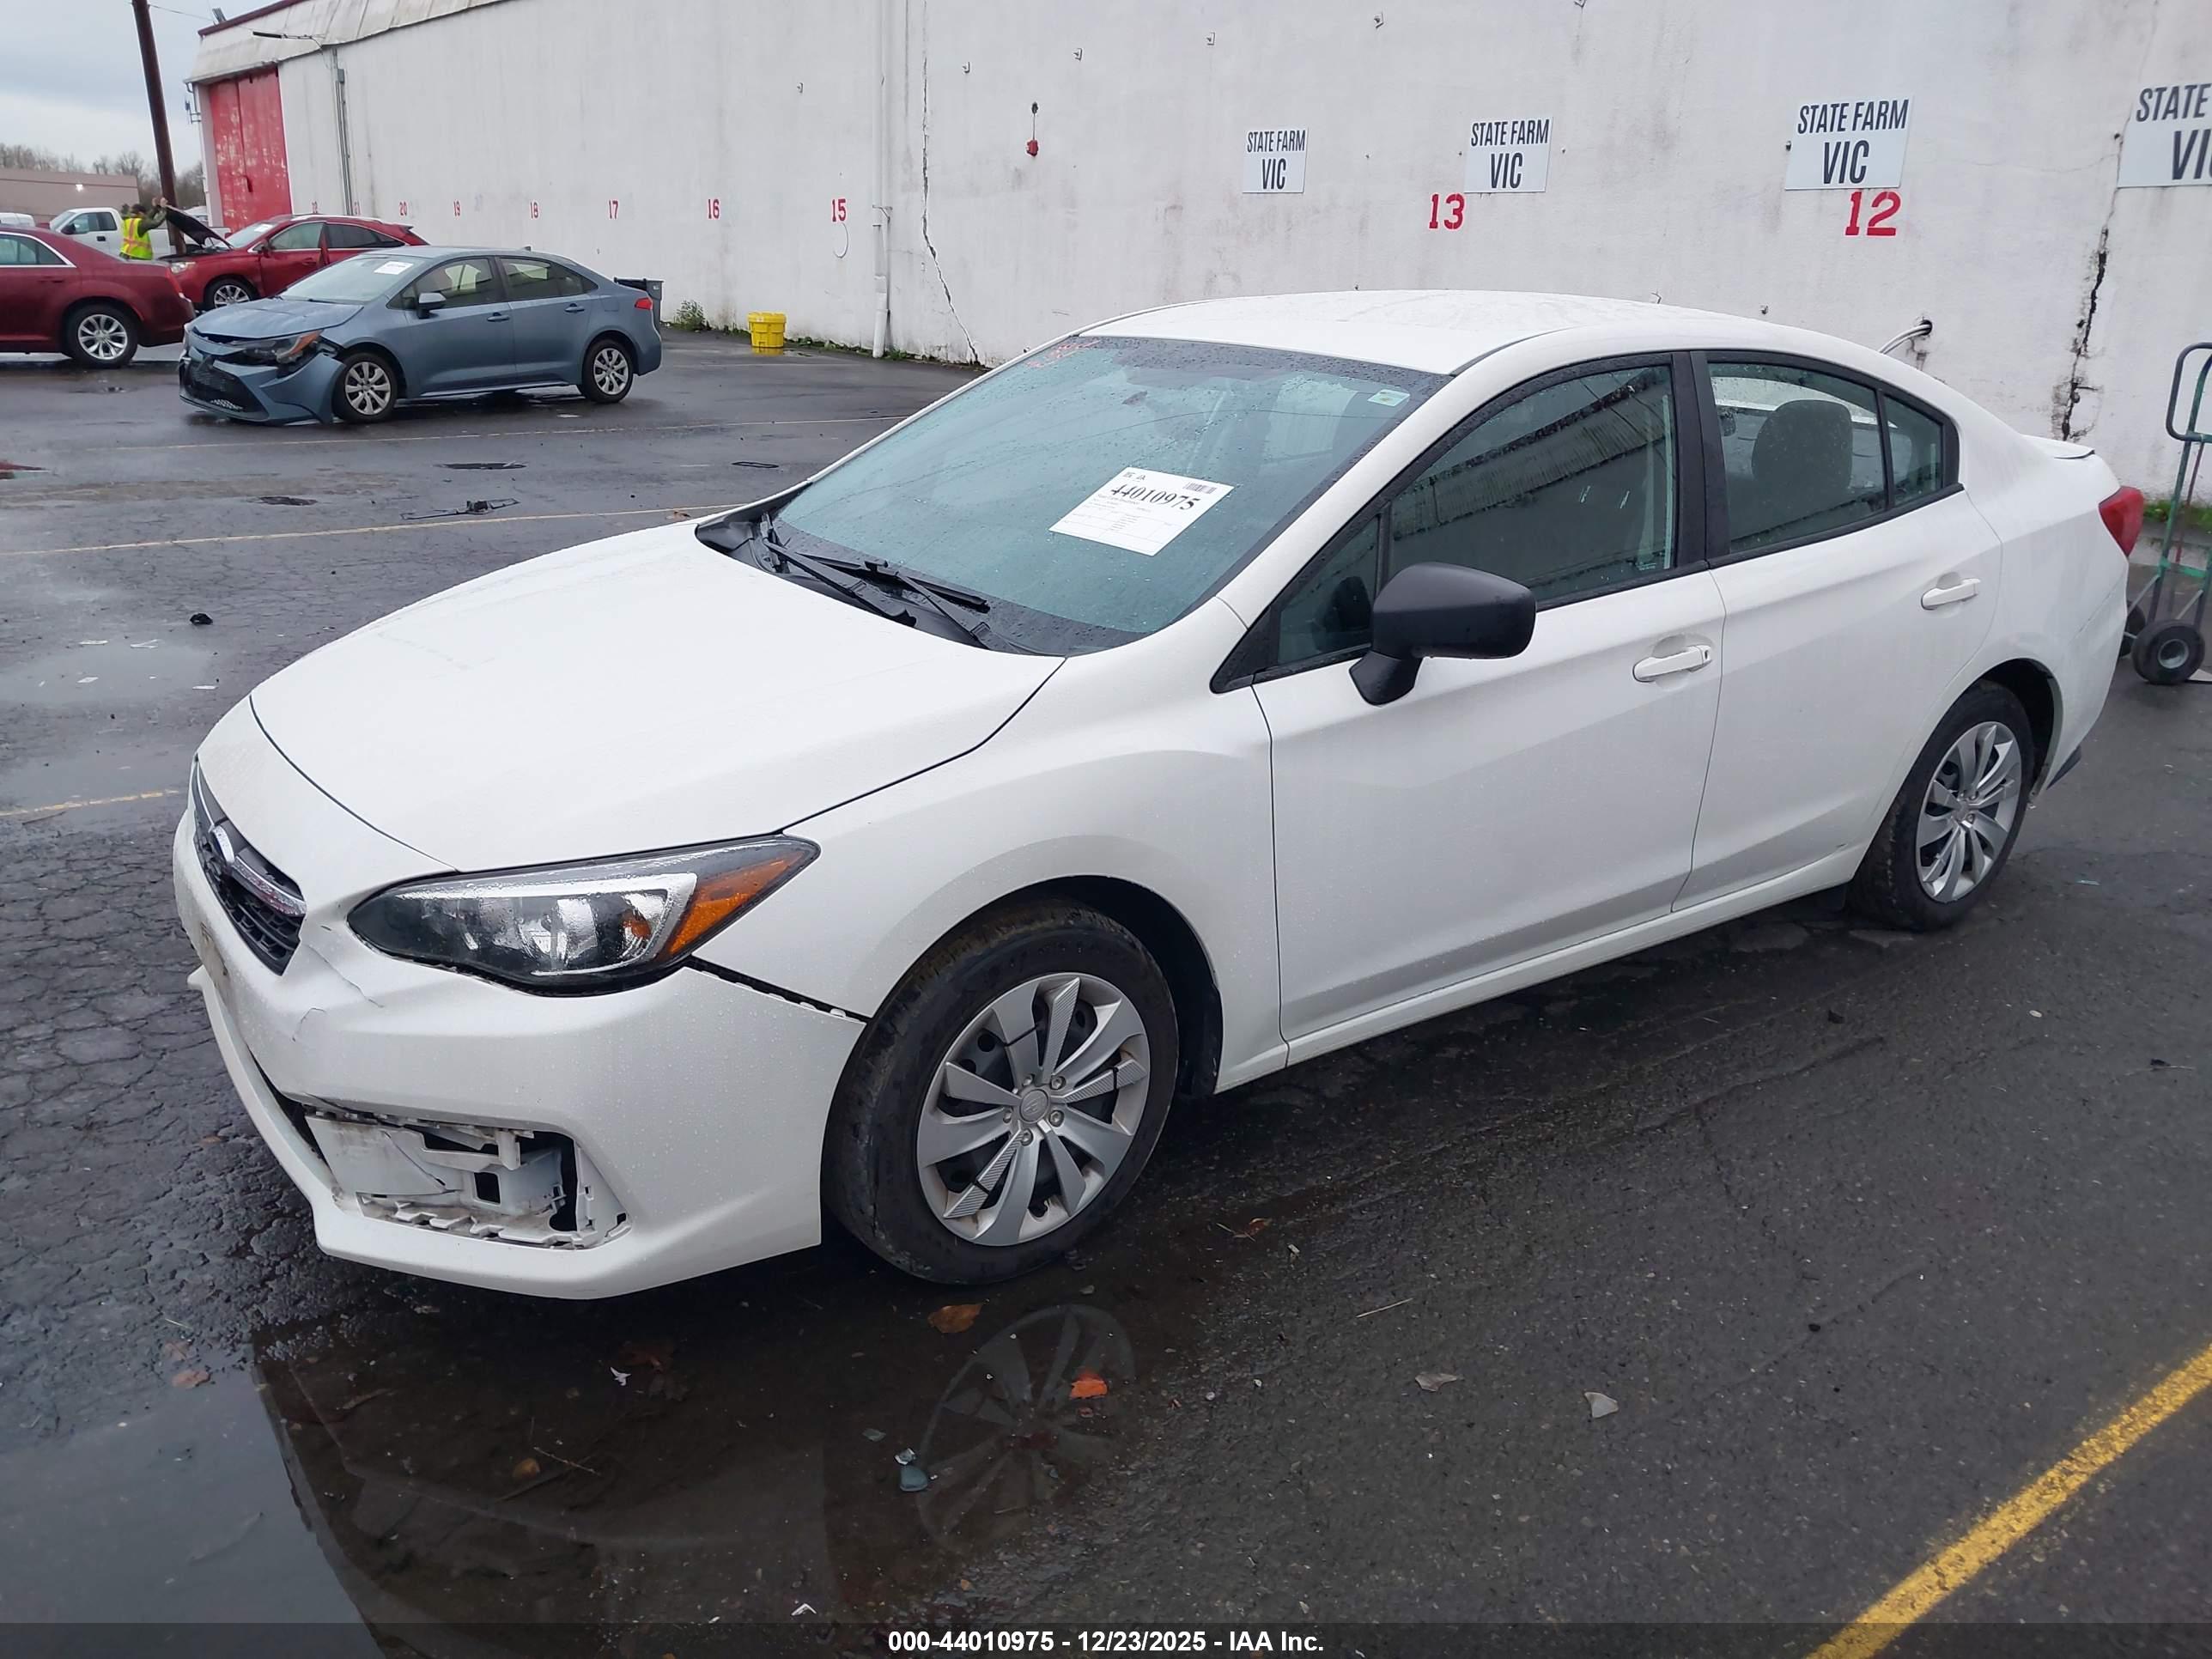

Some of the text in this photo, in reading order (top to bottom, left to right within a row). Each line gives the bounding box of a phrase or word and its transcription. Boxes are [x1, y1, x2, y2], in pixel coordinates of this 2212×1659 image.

[1797, 99, 1909, 134] STATE FARM
[2136, 83, 2212, 122] STATE
[1247, 130, 1306, 153] STATE FARM
[1471, 118, 1550, 147] STATE FARM
[1823, 140, 1870, 185] VIC
[2172, 129, 2212, 180] VI
[1261, 158, 1286, 190] VIC
[1491, 152, 1523, 189] VIC
[399, 202, 408, 216] 20
[453, 201, 461, 216] 19
[530, 202, 538, 219] 18
[608, 199, 619, 220] 17
[707, 198, 720, 220] 16
[831, 198, 847, 222] 15
[1429, 192, 1465, 230] 13
[1844, 191, 1901, 236] 12
[1111, 483, 1200, 511] 44010975
